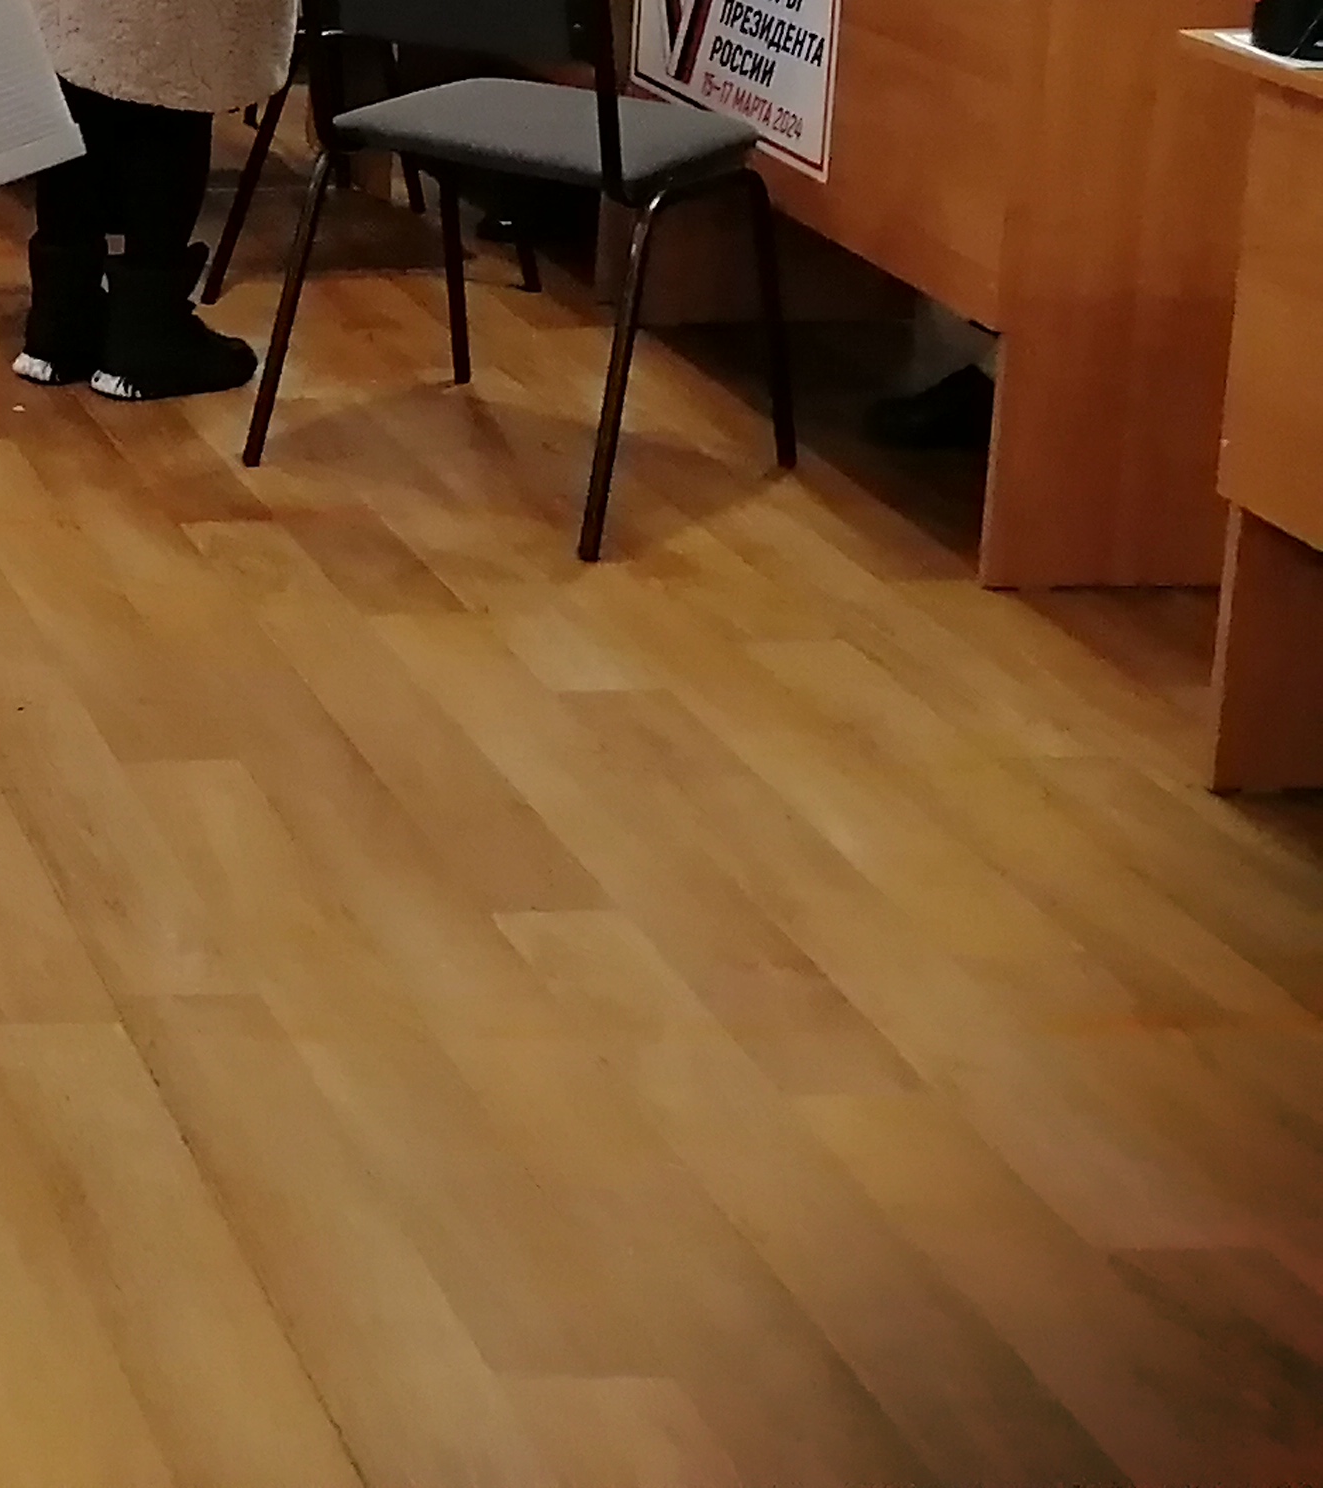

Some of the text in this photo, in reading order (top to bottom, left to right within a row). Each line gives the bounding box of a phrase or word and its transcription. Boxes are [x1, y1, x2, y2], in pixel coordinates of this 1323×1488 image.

[709, 35, 776, 88] РОССИИ
[732, 87, 773, 126] МАРТА
[772, 107, 803, 140] 2024
